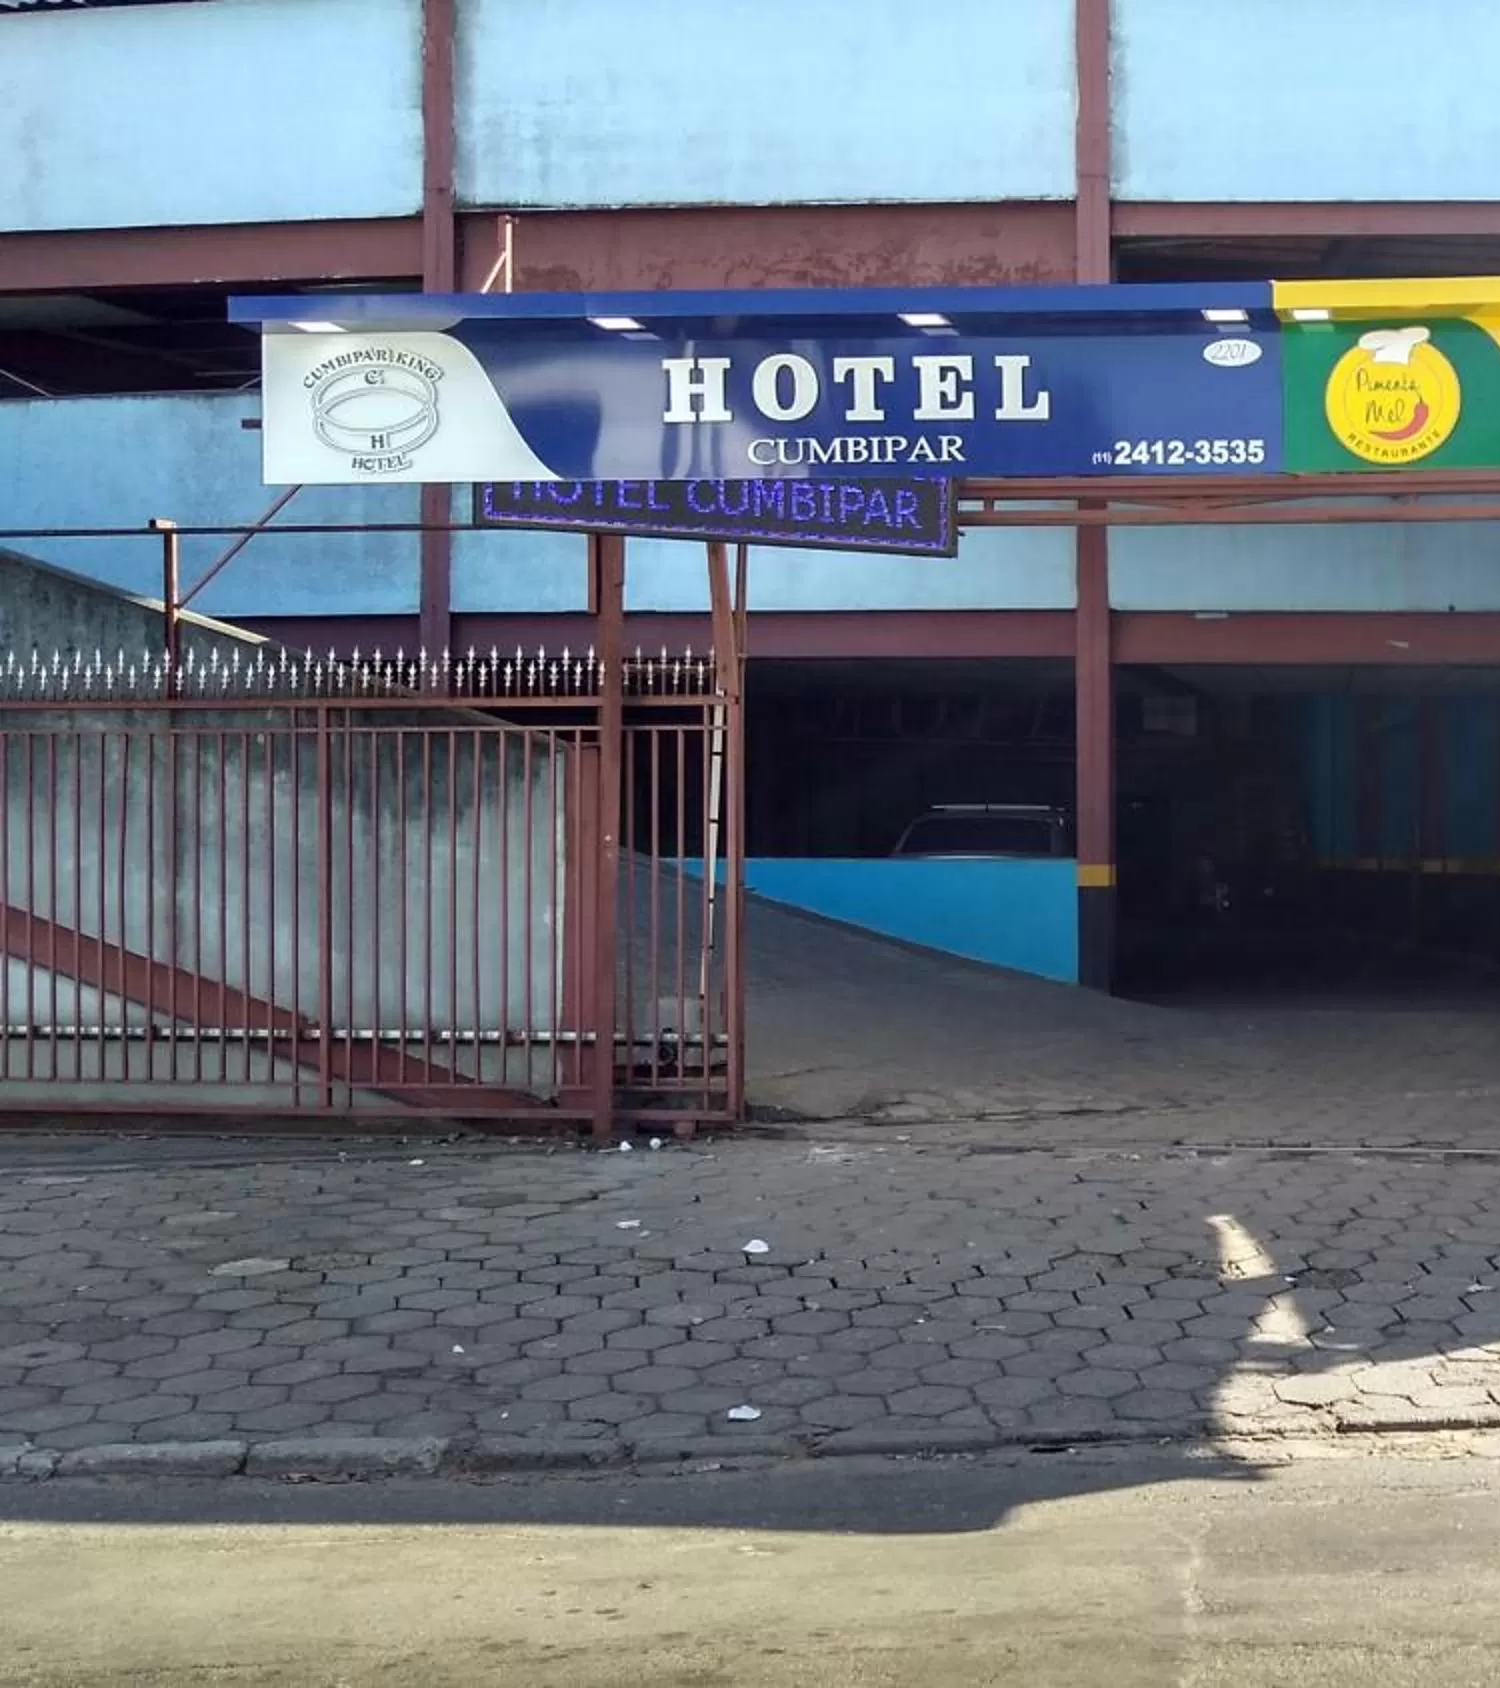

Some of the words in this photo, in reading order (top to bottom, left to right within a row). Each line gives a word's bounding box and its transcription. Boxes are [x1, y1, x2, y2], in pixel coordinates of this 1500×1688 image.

[303, 348, 389, 389] CUMBIPAR
[396, 351, 443, 382] KING
[1355, 368, 1419, 393] Pimenta
[662, 353, 1050, 423] HOTEL
[1365, 399, 1405, 424] Mel
[747, 435, 965, 465] CUMBIPAR
[1092, 450, 1112, 464] (11)
[1114, 439, 1265, 465] 2412-3535
[687, 479, 923, 528] CUMBIPAR
